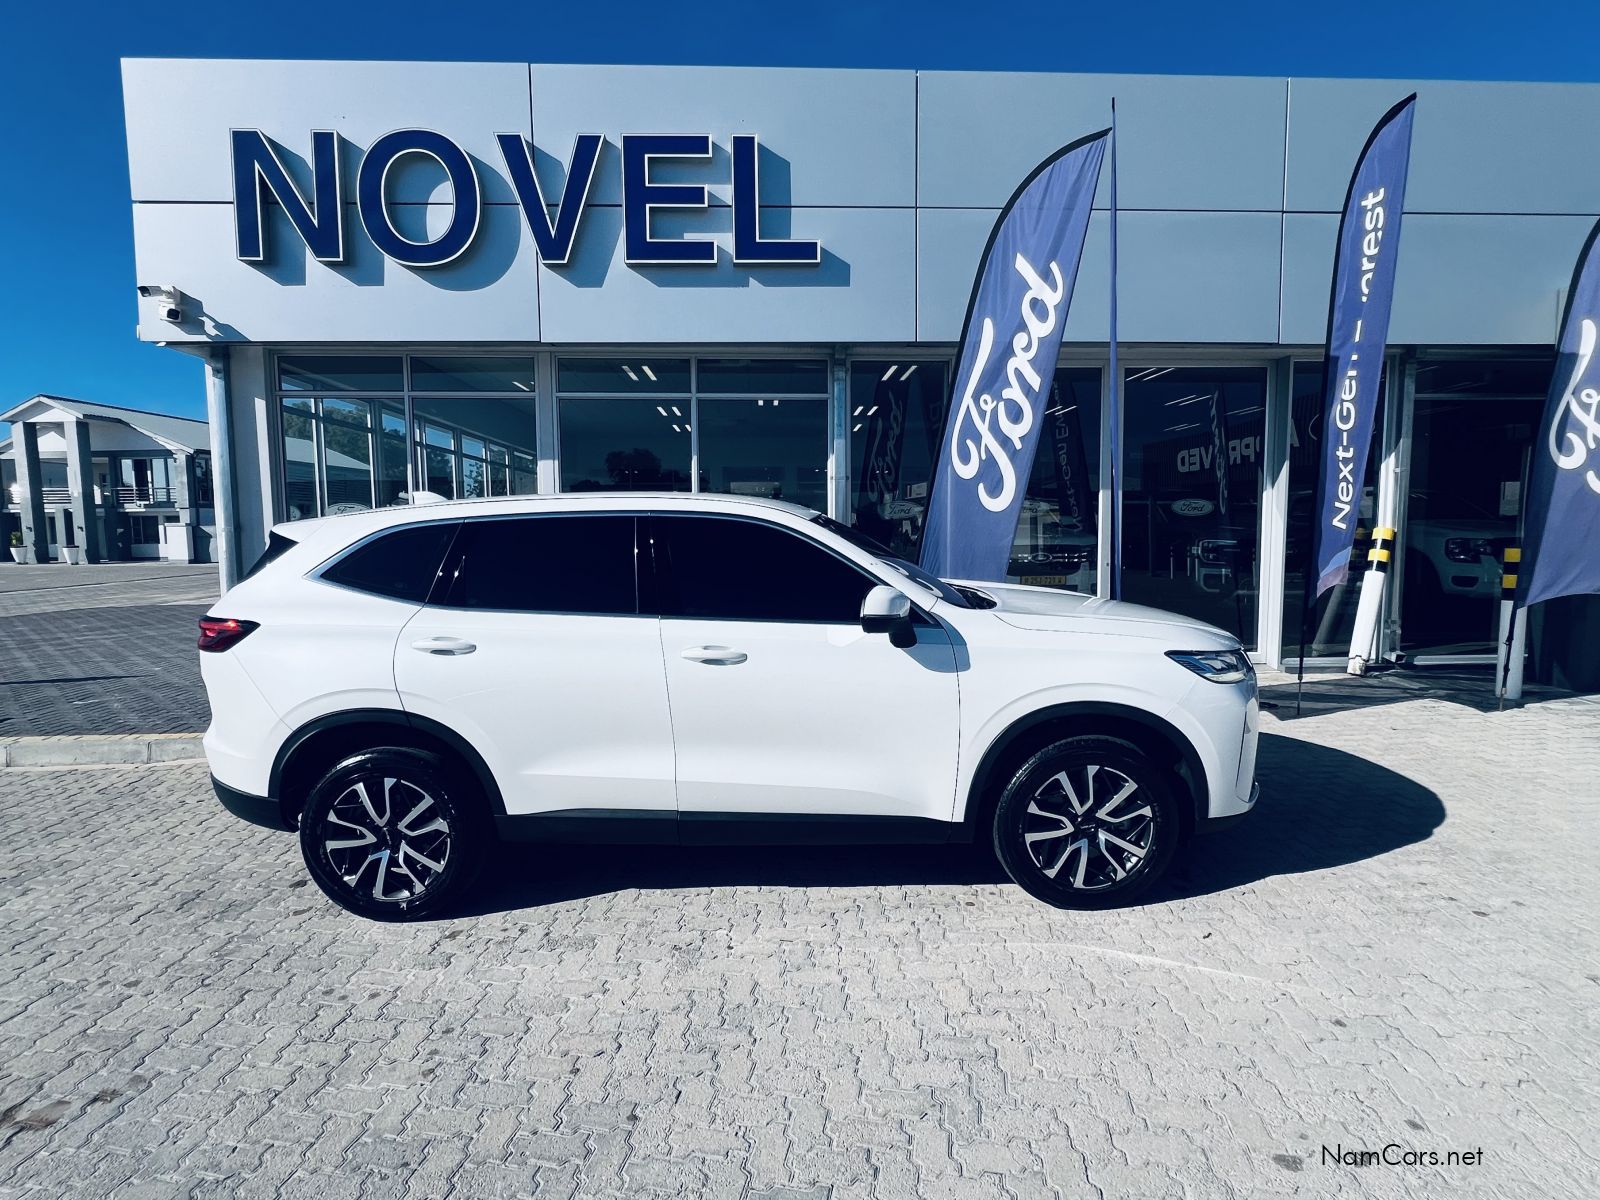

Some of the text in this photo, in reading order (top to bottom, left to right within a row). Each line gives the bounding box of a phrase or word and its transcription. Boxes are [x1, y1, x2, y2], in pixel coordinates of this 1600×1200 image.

[229, 127, 821, 267] NOVEL
[1354, 188, 1385, 342] rest
[952, 253, 1064, 512] Ford
